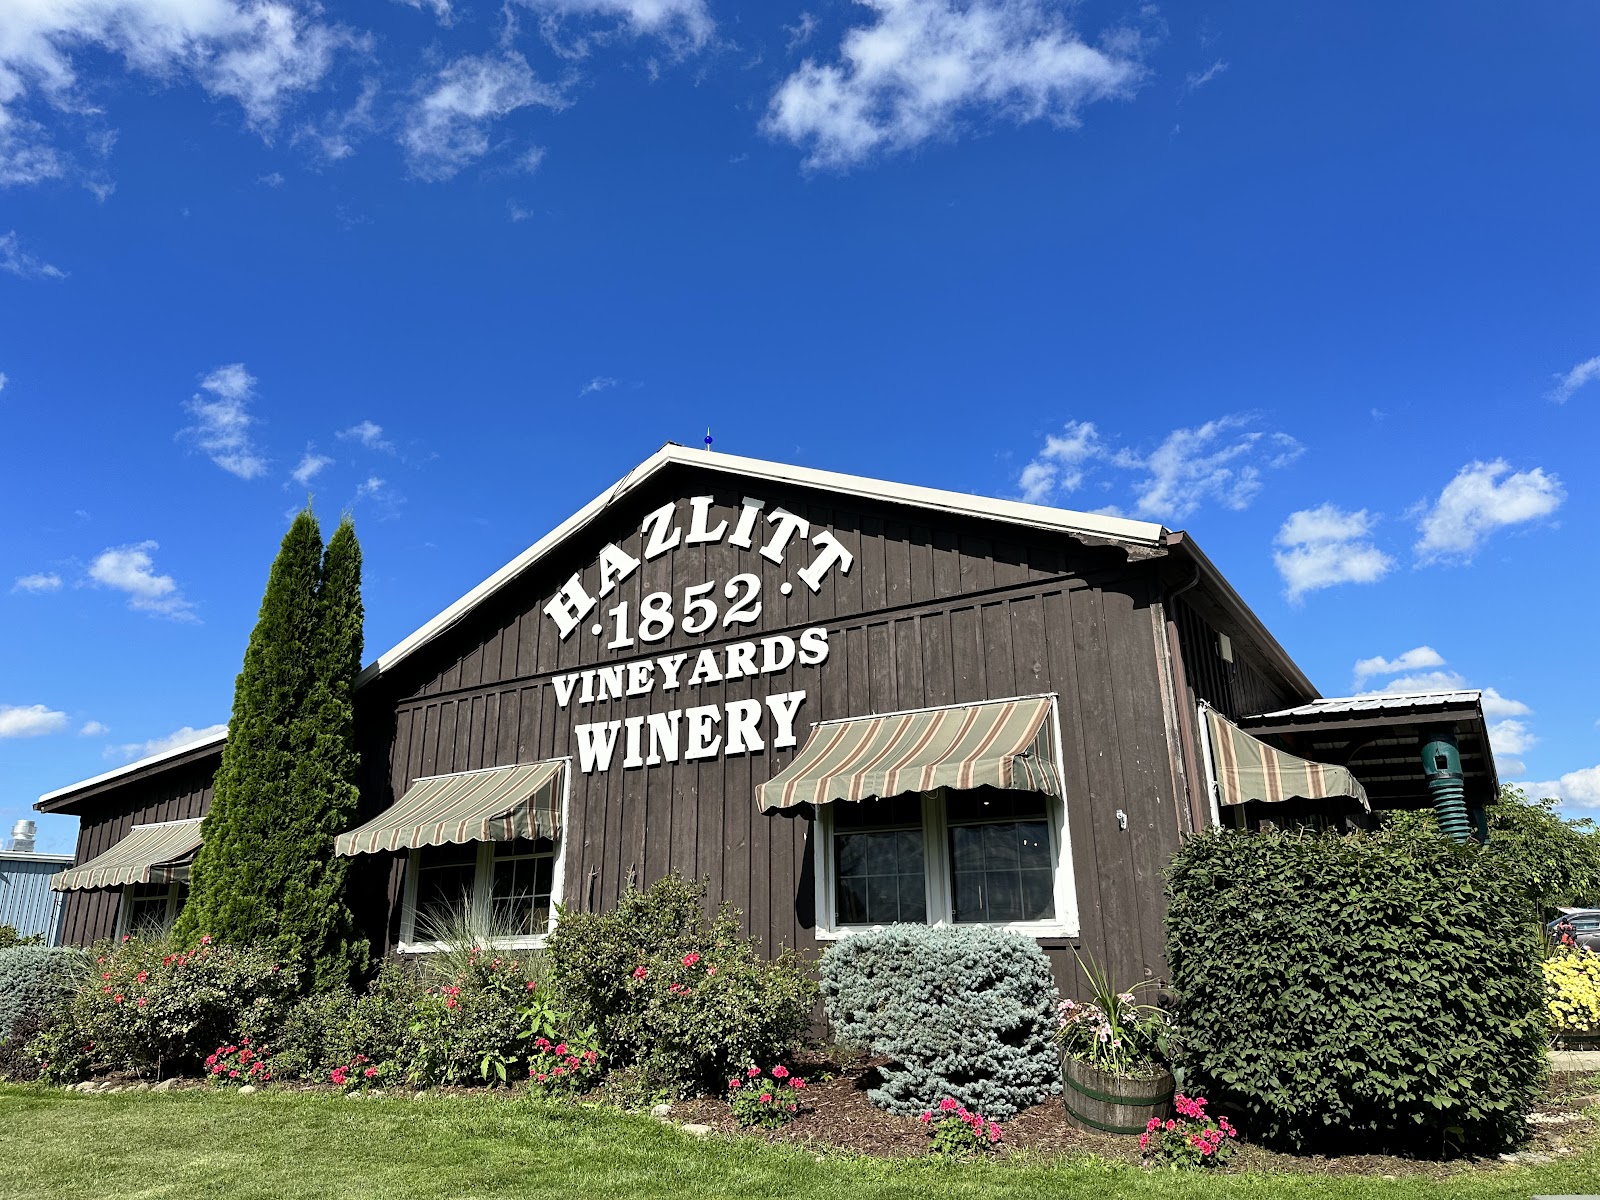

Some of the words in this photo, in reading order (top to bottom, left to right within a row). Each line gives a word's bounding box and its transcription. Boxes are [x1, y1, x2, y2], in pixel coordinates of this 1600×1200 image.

[542, 494, 854, 640] HAZLITT
[551, 627, 830, 707] VINEYARDS
[574, 690, 807, 773] WINERY
